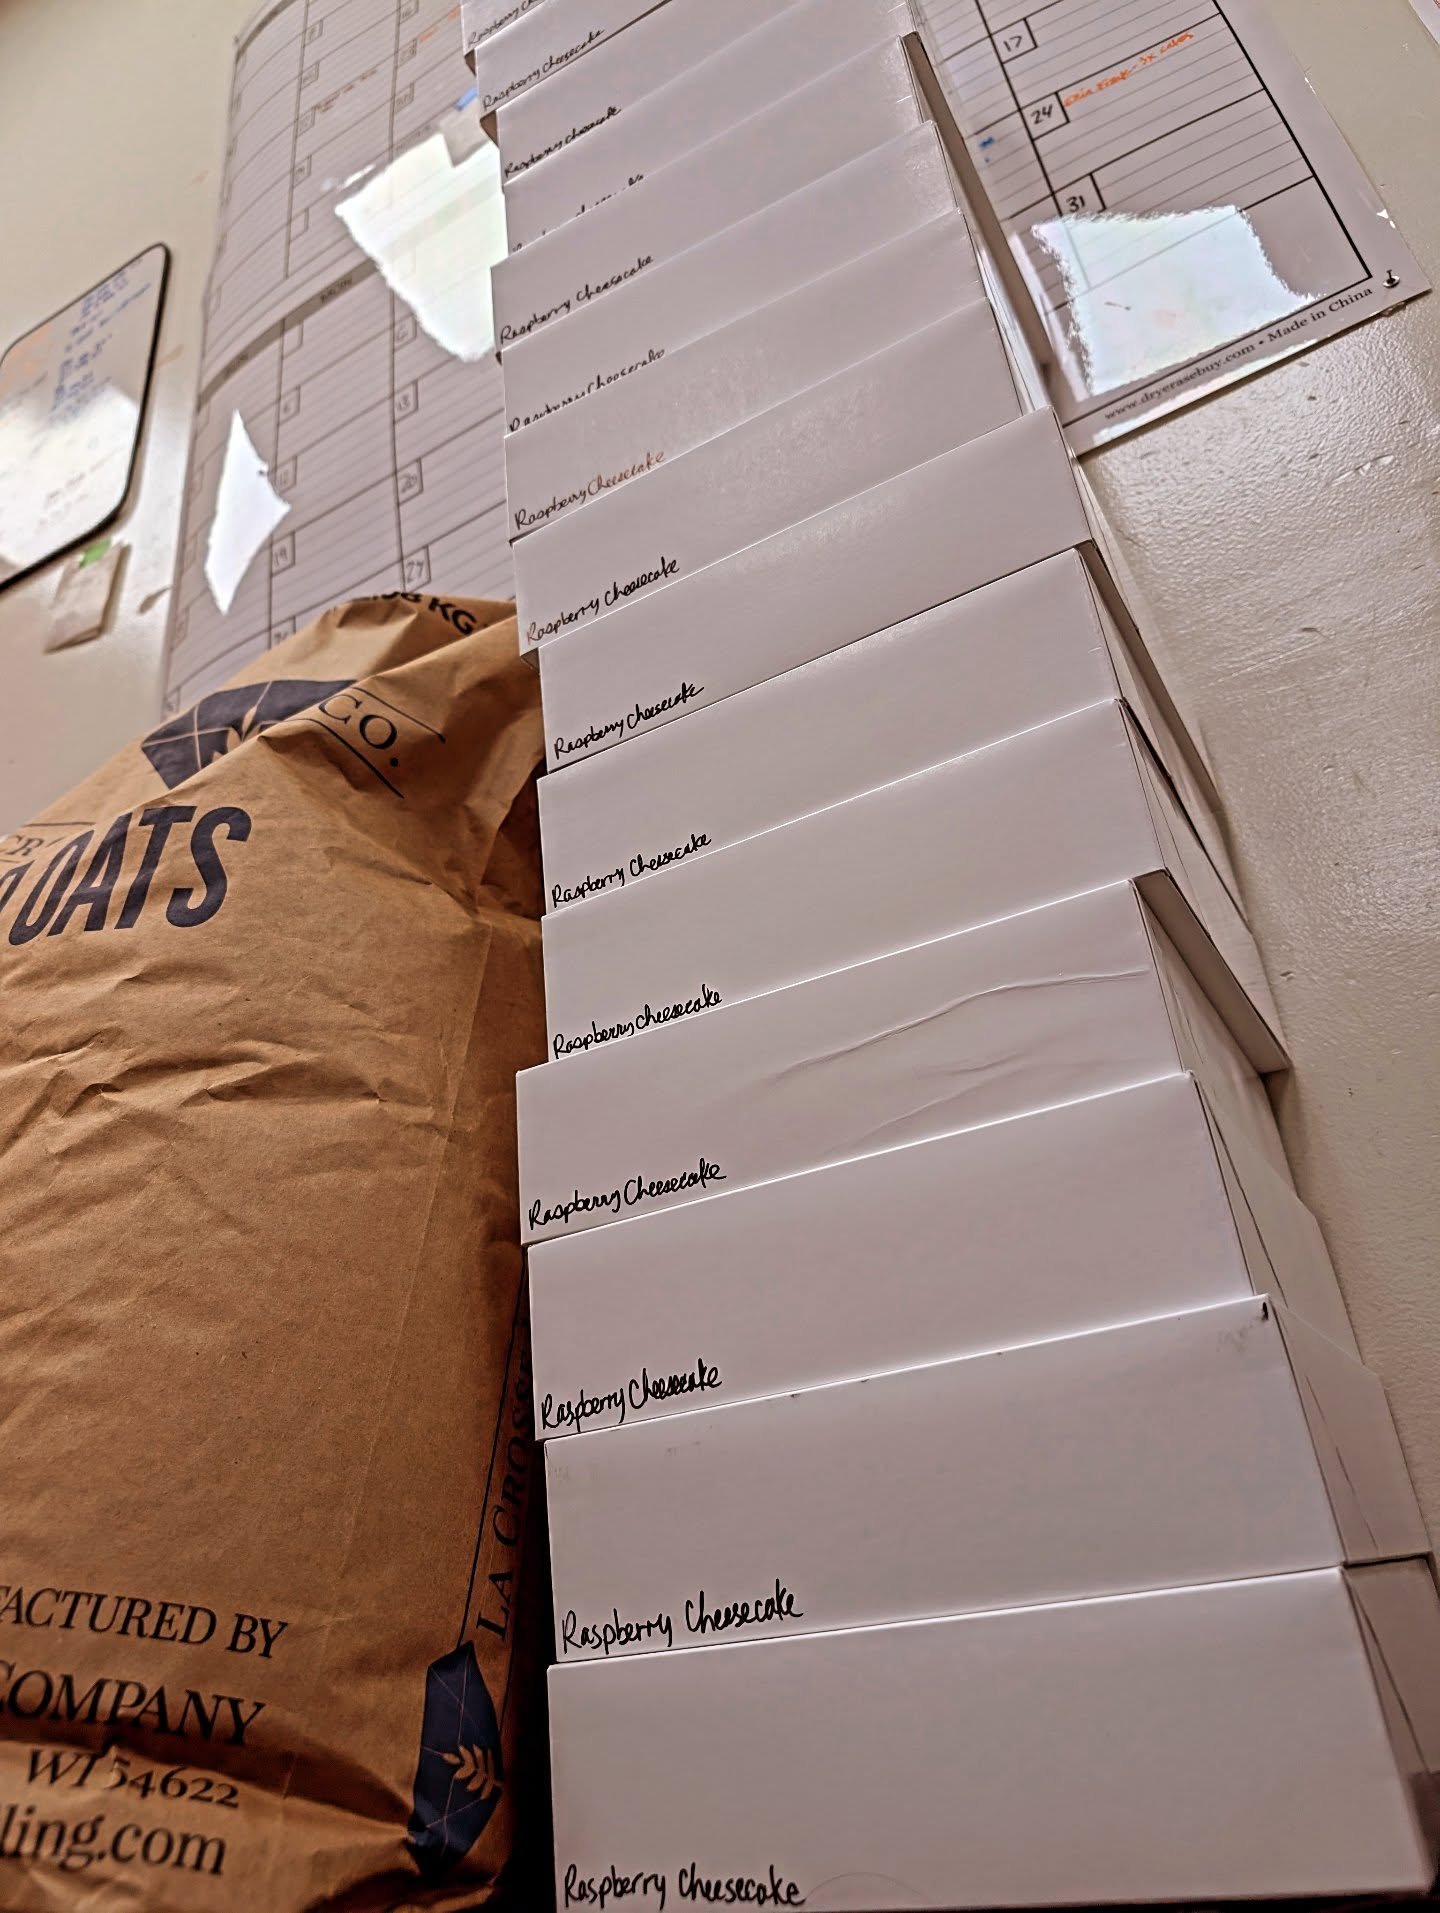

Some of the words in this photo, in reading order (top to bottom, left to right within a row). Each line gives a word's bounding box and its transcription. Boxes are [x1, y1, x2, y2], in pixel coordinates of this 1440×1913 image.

[1003, 35, 1023, 52] 17
[1030, 105, 1053, 125] 24
[1065, 194, 1086, 213] 31
[500, 299, 571, 345] Raspberry
[1104, 342, 1257, 420] www.dryerasebuy.com
[1267, 319, 1309, 343] Made
[1311, 309, 1327, 324] in
[1328, 286, 1374, 313] China
[514, 488, 587, 530] Raspberry
[587, 450, 665, 497] Cheesecake
[526, 597, 600, 646] Raspberry
[604, 556, 680, 607] Cheesecake
[317, 692, 400, 769] CO.
[553, 719, 625, 760] Raspberry
[626, 681, 705, 729] Cheesecake
[8, 806, 253, 947] OATS
[551, 867, 625, 908] Raspberry
[629, 833, 712, 876] Cheesecake
[552, 1020, 635, 1060] Raspberry
[528, 1189, 621, 1231] Raspberry
[623, 1157, 727, 1205] Cheesecake
[541, 1388, 625, 1433] Raspberry
[628, 1357, 723, 1409] Cheesecake
[226, 1612, 290, 1659] BY
[476, 1570, 514, 1640] LA
[561, 1608, 673, 1655] Raspberry
[685, 1577, 804, 1633] Cheesecake
[27, 1748, 105, 1788] WI
[102, 1755, 240, 1810] 54622
[564, 1863, 667, 1911] Raspberry
[678, 1861, 807, 1906] Cheesecake
